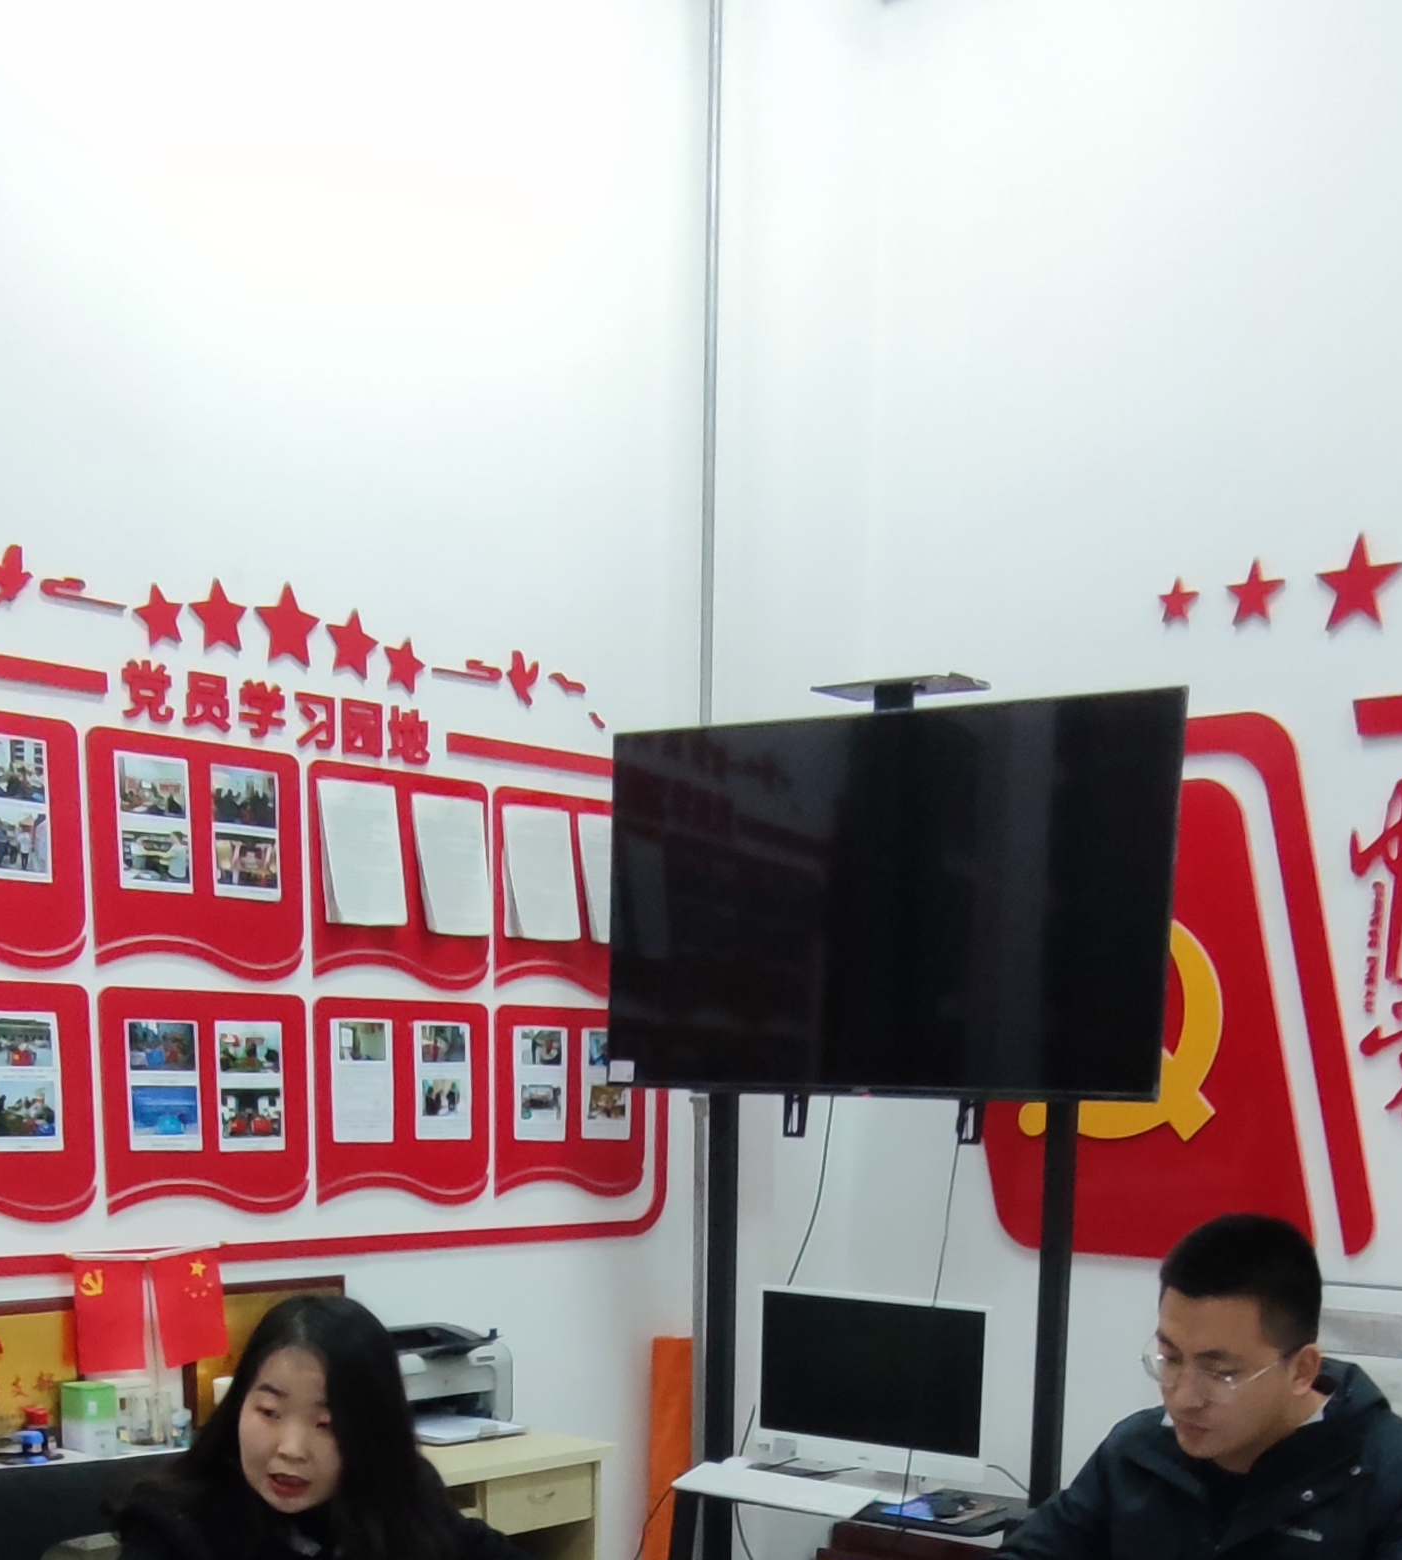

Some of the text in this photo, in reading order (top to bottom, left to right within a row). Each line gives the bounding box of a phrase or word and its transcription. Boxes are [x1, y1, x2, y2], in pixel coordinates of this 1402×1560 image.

[121, 659, 431, 766] 党员学习园地
